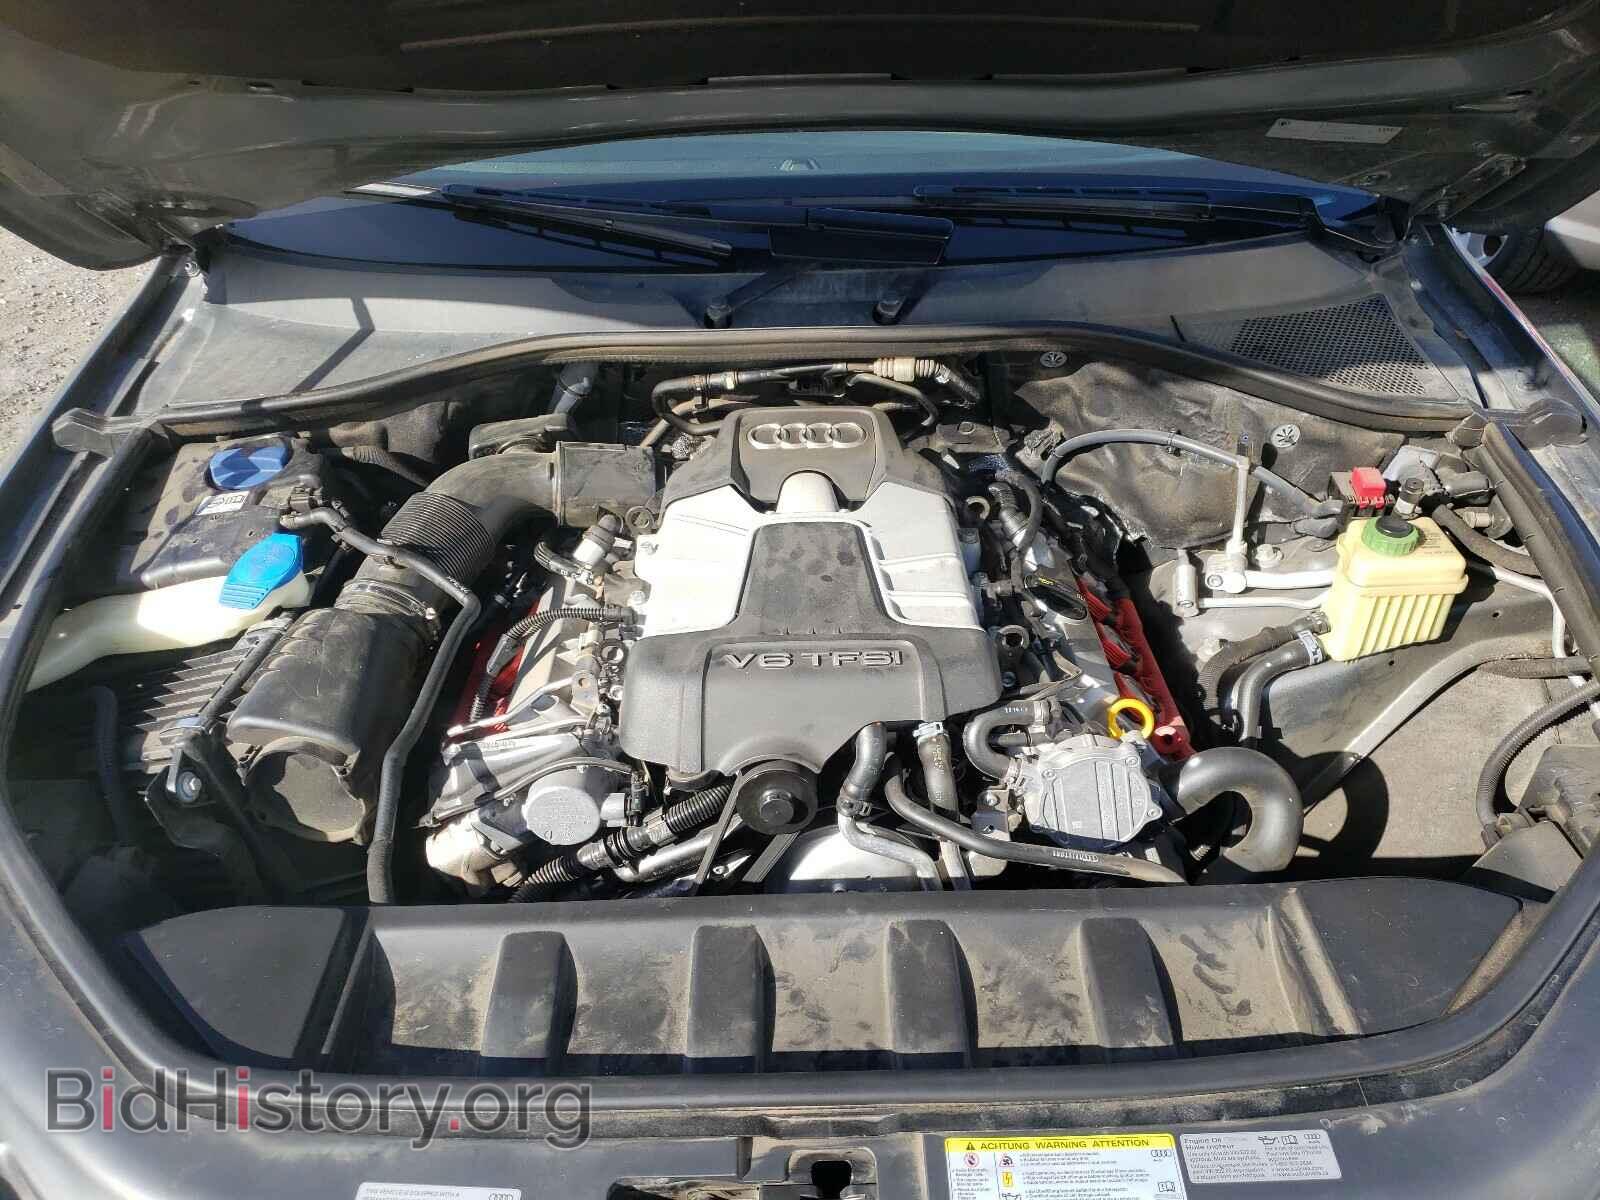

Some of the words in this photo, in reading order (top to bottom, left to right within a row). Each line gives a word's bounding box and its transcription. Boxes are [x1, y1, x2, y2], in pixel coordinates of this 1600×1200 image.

[724, 651, 794, 669] V6
[801, 649, 904, 667] TFSI
[981, 1142, 1030, 1150] ACHTUNG
[1036, 1141, 1087, 1149] WARNING
[1092, 1139, 1150, 1148] ATTENTION
